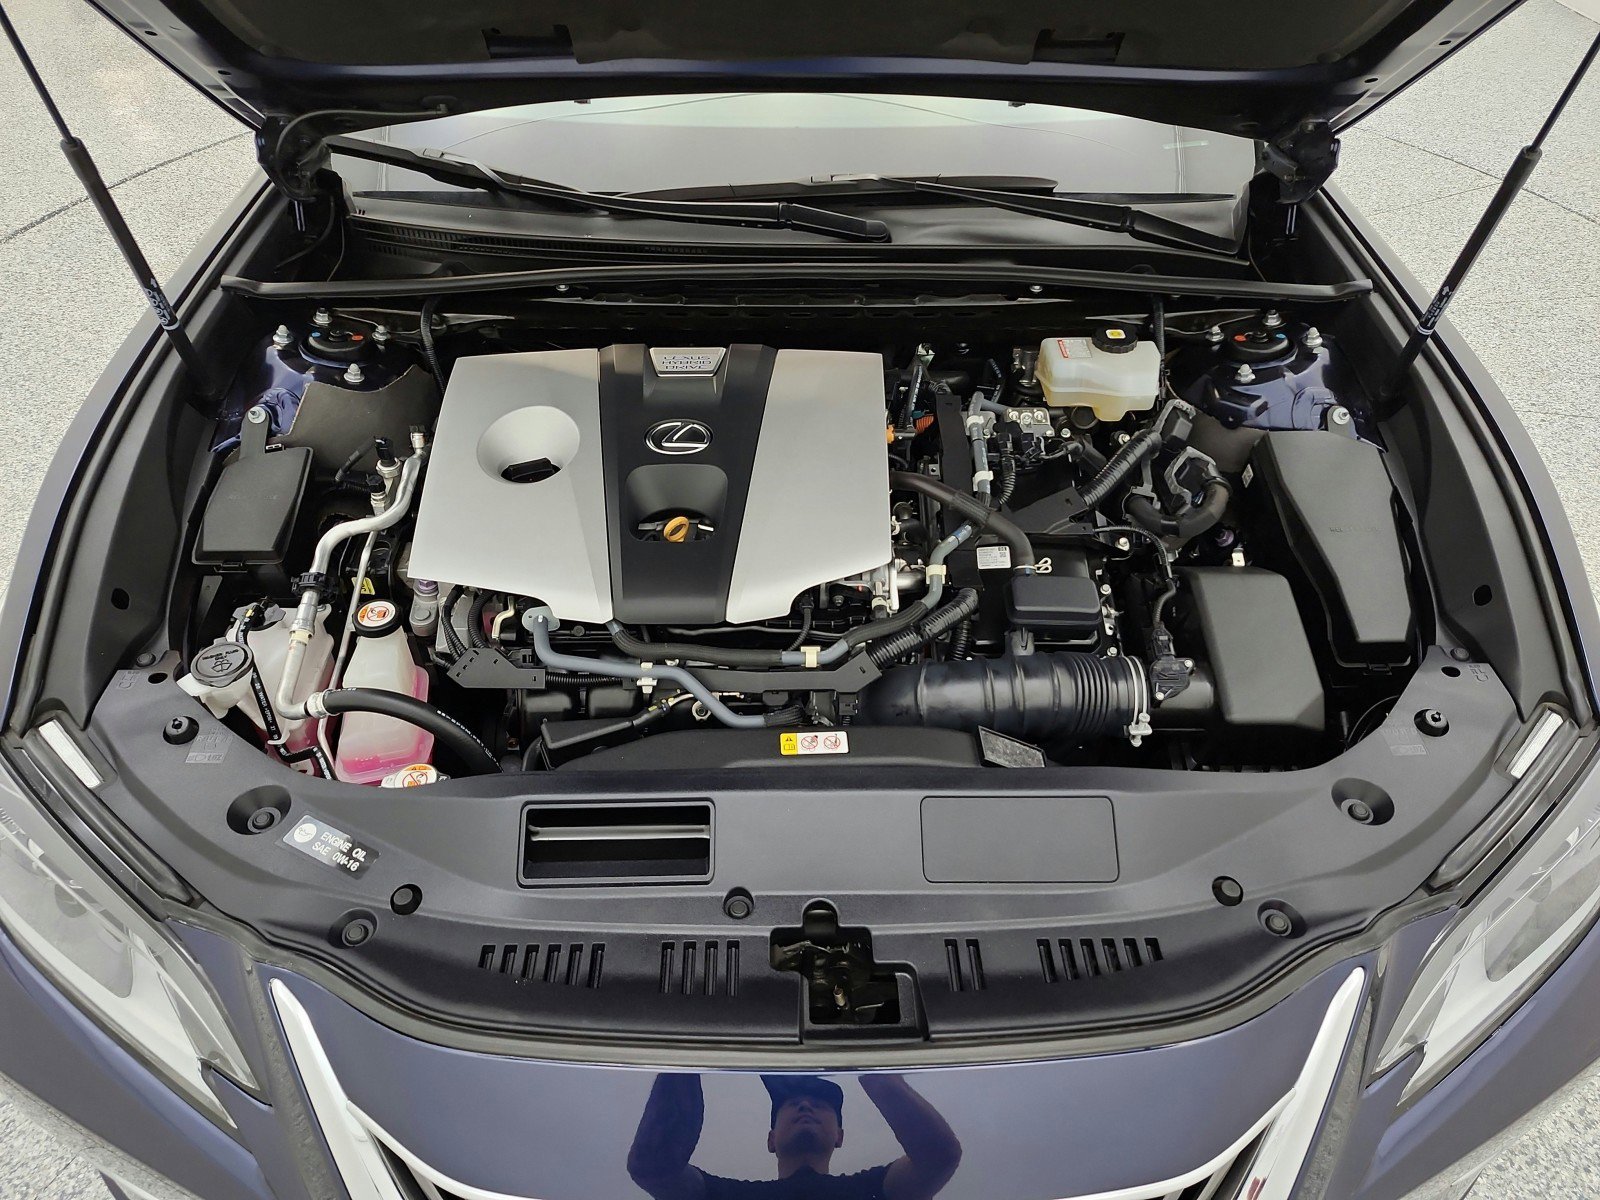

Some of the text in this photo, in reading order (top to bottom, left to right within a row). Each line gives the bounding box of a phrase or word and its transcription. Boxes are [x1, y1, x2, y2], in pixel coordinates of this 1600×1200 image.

[312, 841, 360, 872] SAE 0W-16
[320, 831, 367, 862] ENGINE OIL
